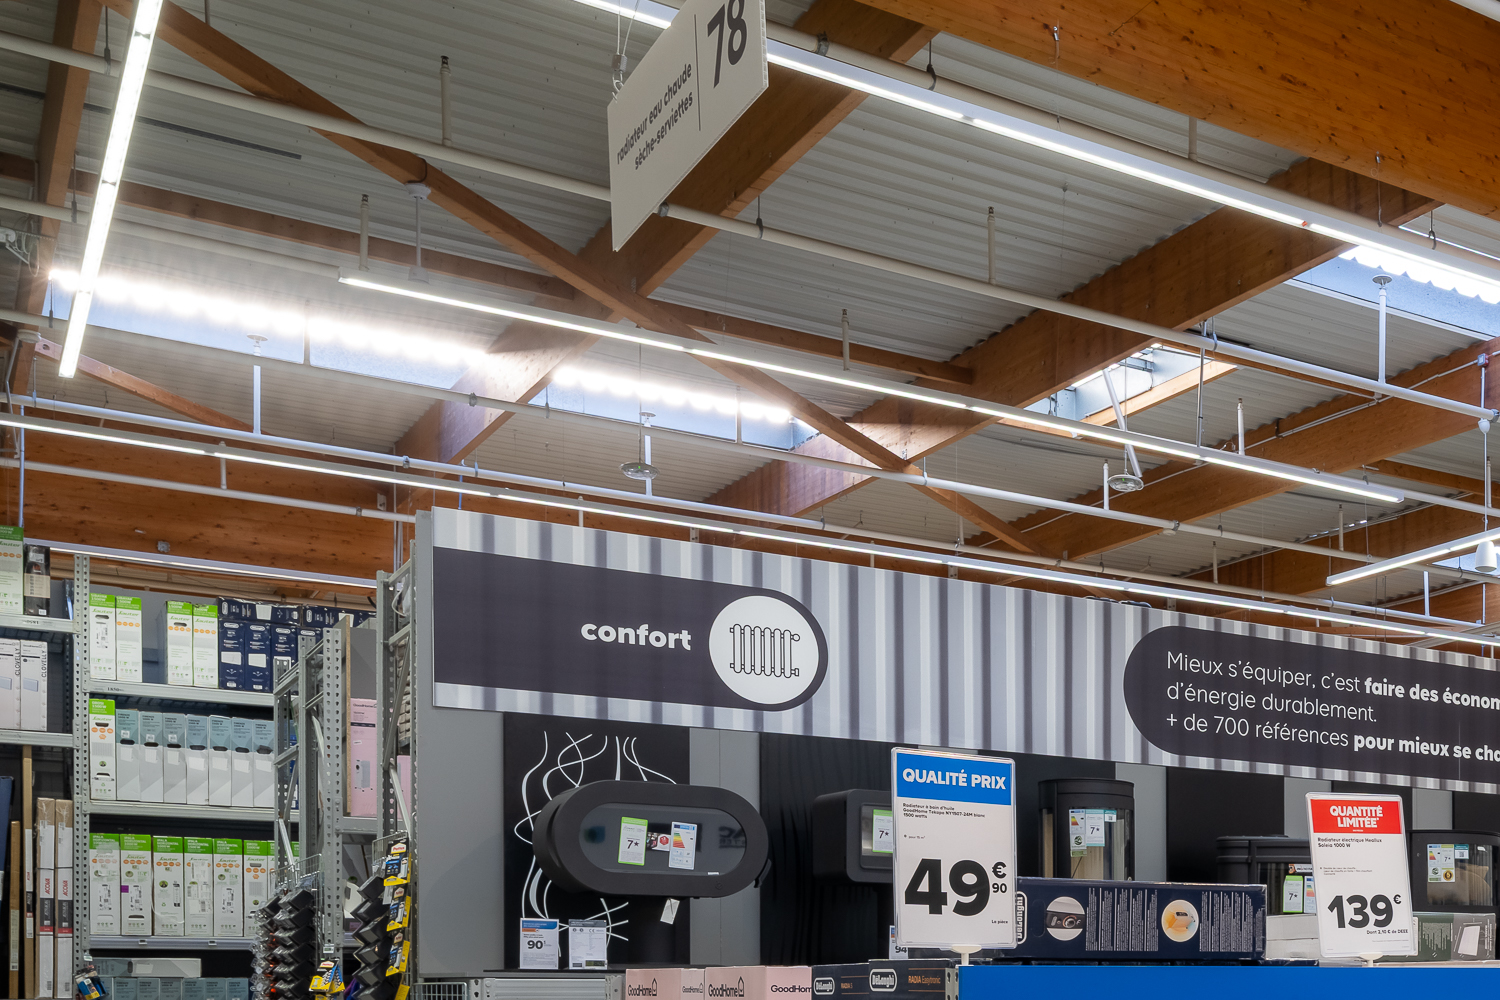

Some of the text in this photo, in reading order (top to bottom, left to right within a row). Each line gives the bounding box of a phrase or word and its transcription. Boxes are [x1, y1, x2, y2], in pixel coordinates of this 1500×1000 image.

[707, 0, 747, 88] 78
[617, 63, 692, 164] radiateur eau chaude
[635, 91, 693, 170] sèche-serviettes
[580, 622, 691, 651] confort
[1167, 650, 1223, 676] Mieux
[1364, 677, 1405, 697] faire
[1409, 683, 1438, 702] des
[1262, 693, 1377, 723] durablement.
[1167, 714, 1178, 727] +
[1183, 715, 1207, 732] de
[1214, 715, 1249, 736] 700
[1255, 722, 1348, 747] références
[1353, 733, 1394, 752] pour
[1399, 737, 1449, 758] mieux
[1453, 744, 1471, 760] se
[902, 768, 1006, 789] QUALITÉ PRIX
[1330, 805, 1383, 817] QUANTITÉ
[905, 858, 1007, 916] 49 €
[992, 882, 1007, 893] 90
[1328, 894, 1401, 928] 139 €
[628, 984, 652, 996] GoodHome
[708, 983, 738, 997] GoodHome
